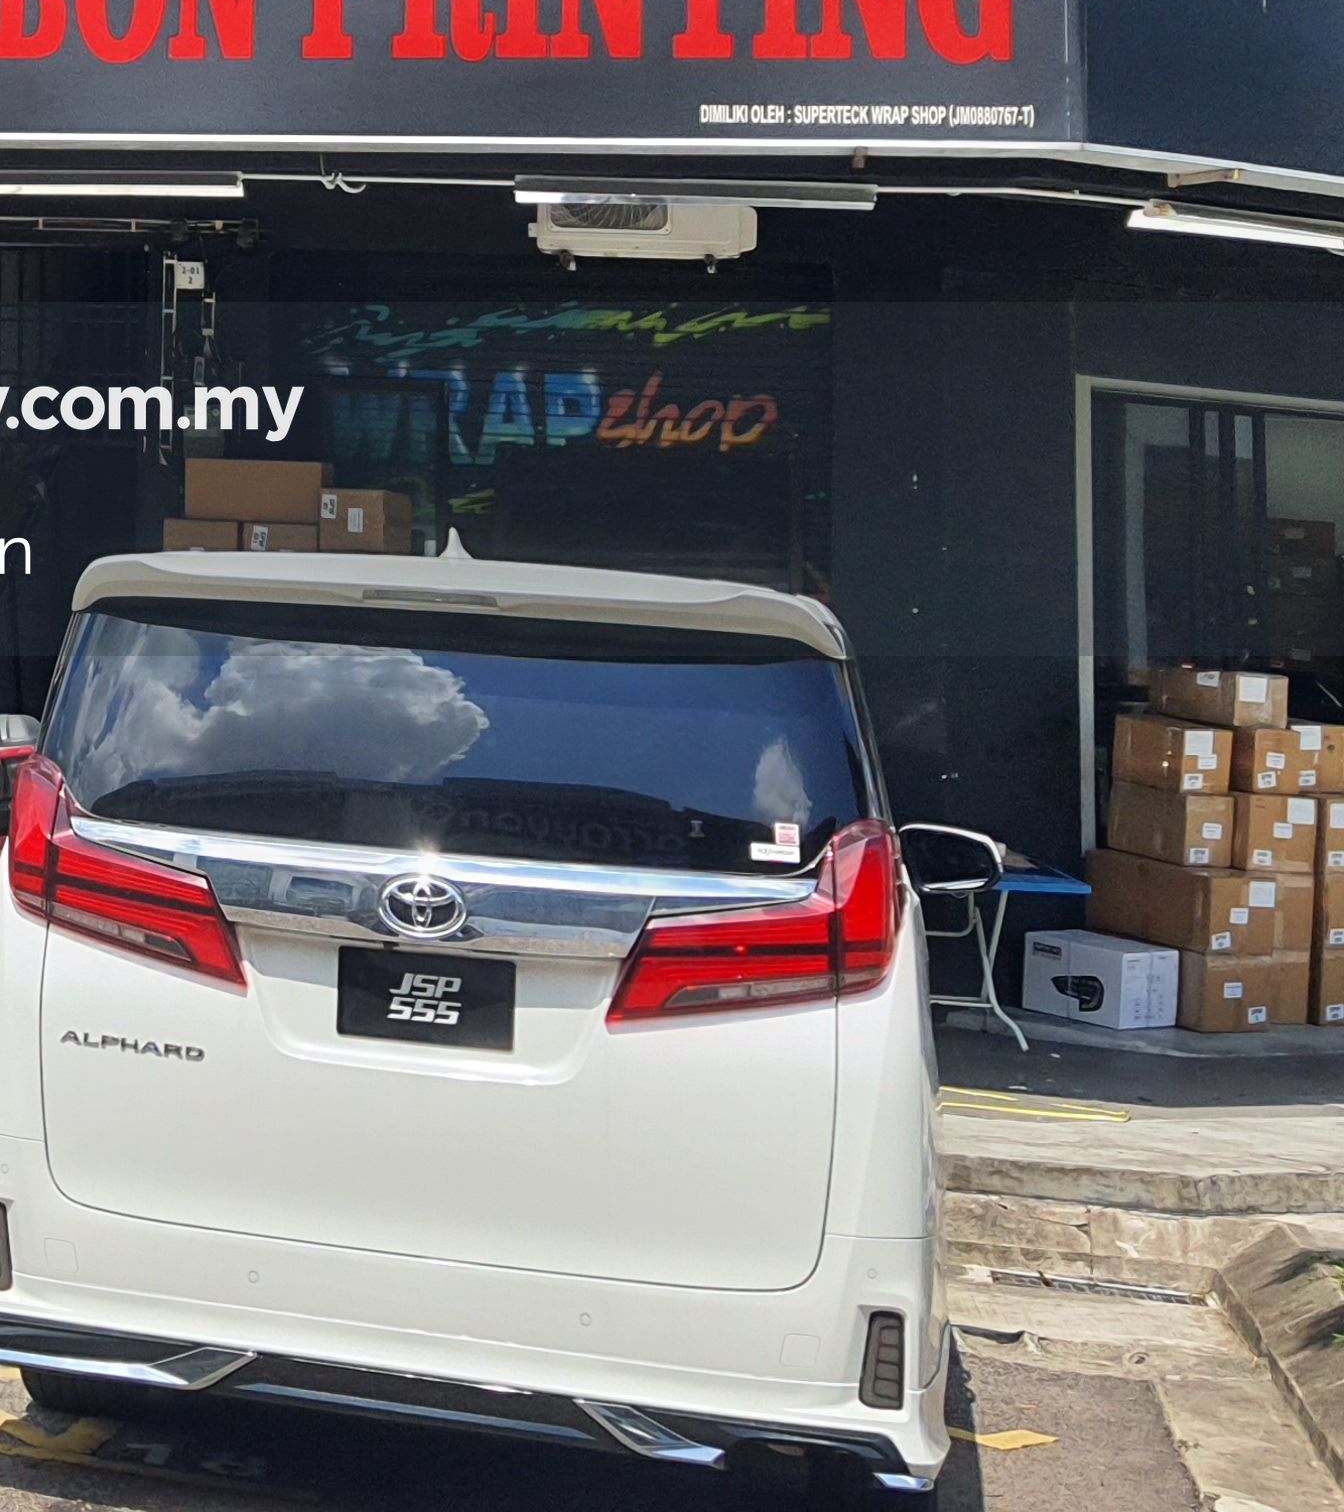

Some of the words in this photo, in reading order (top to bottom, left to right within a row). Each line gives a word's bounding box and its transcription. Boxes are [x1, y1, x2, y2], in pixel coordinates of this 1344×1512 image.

[699, 103, 749, 124] DIMILIKI
[750, 104, 786, 124] OLEH
[793, 104, 868, 125] SUPERTECK
[869, 105, 909, 125] WRAP
[911, 105, 947, 126] SHOP
[948, 104, 1035, 128] (JM0880767-T)
[388, 972, 463, 998] JSP
[386, 996, 463, 1026] 555
[60, 1030, 205, 1062] ALPHARD
